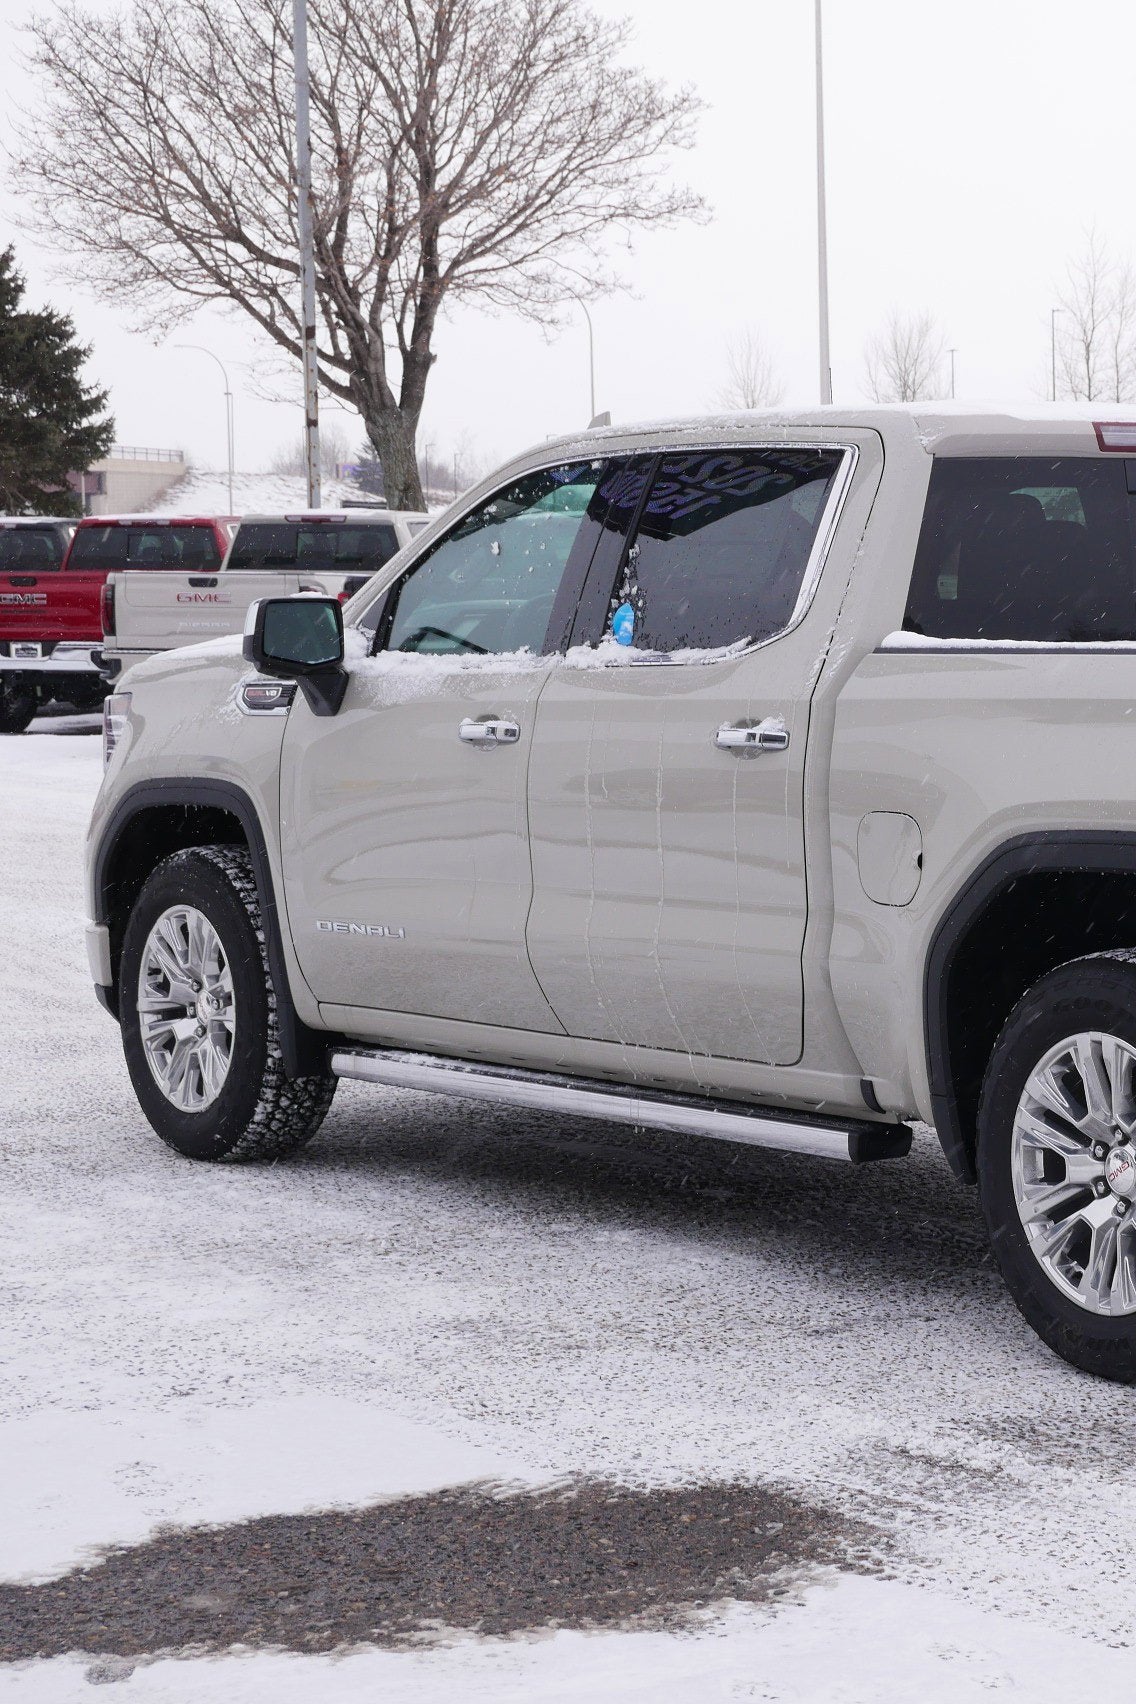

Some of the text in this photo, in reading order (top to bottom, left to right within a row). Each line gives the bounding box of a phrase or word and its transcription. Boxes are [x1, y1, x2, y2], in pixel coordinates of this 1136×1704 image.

[0, 593, 47, 605] GMC
[176, 592, 232, 603] GMC
[316, 919, 406, 939] DENALI
[1108, 1160, 1130, 1182] GMC
